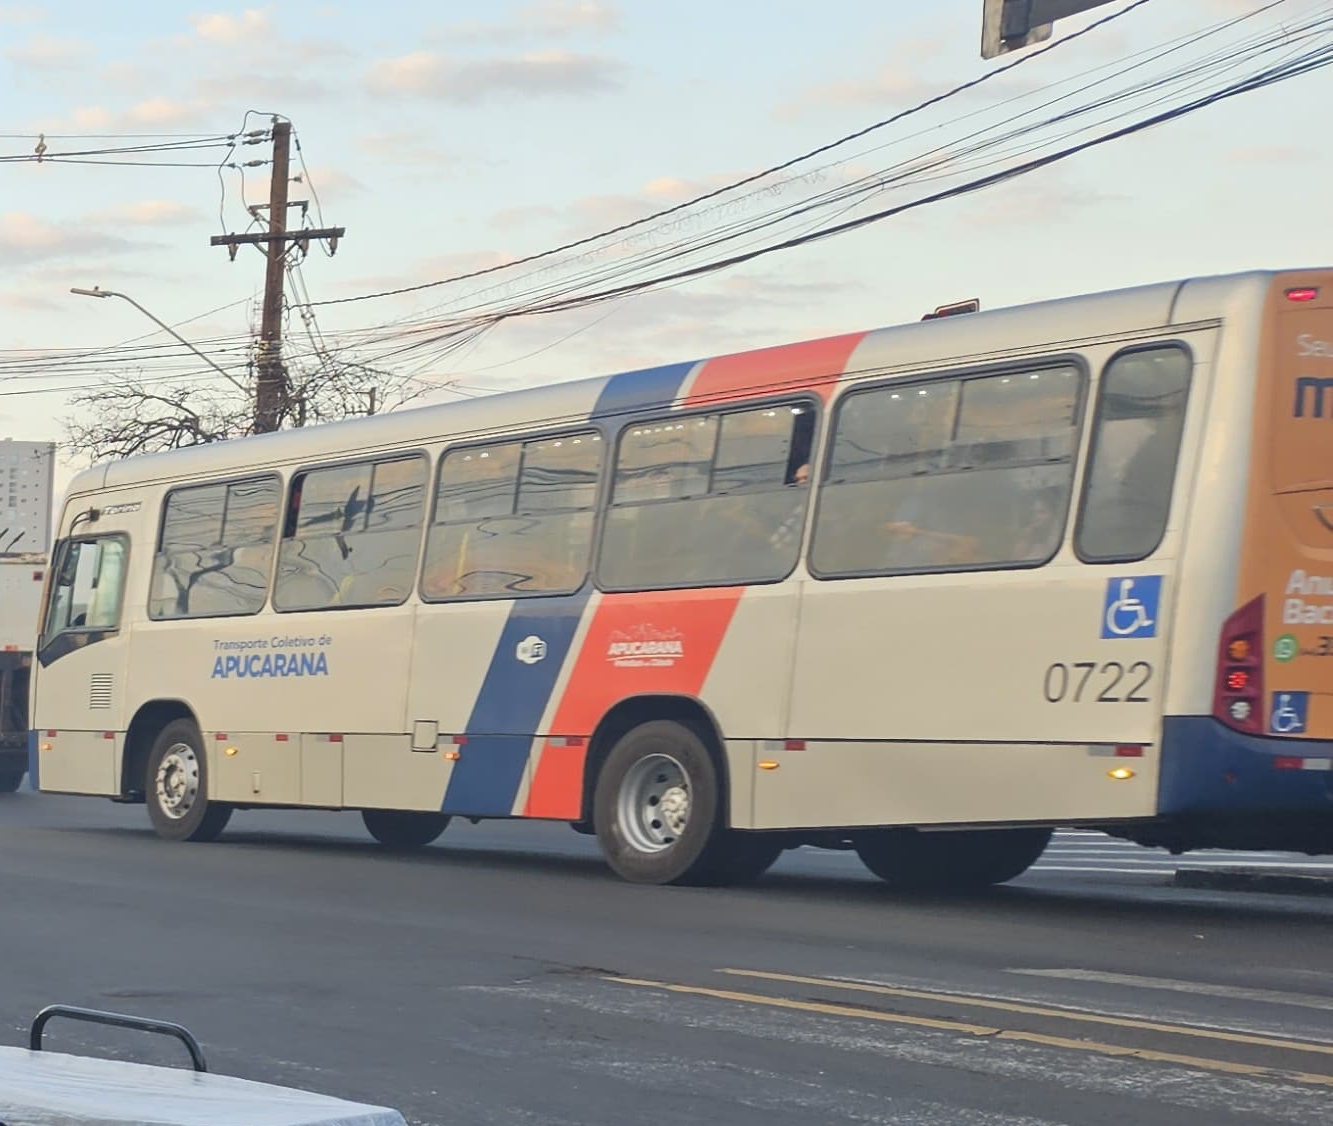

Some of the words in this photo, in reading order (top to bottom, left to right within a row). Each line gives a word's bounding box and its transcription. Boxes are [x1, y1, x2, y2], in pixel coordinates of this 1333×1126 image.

[213, 639, 268, 651] Transporte
[270, 636, 316, 648] Coletivo
[319, 633, 332, 646] de
[211, 652, 329, 679] APUCARANA
[1043, 661, 1154, 703] 0722
